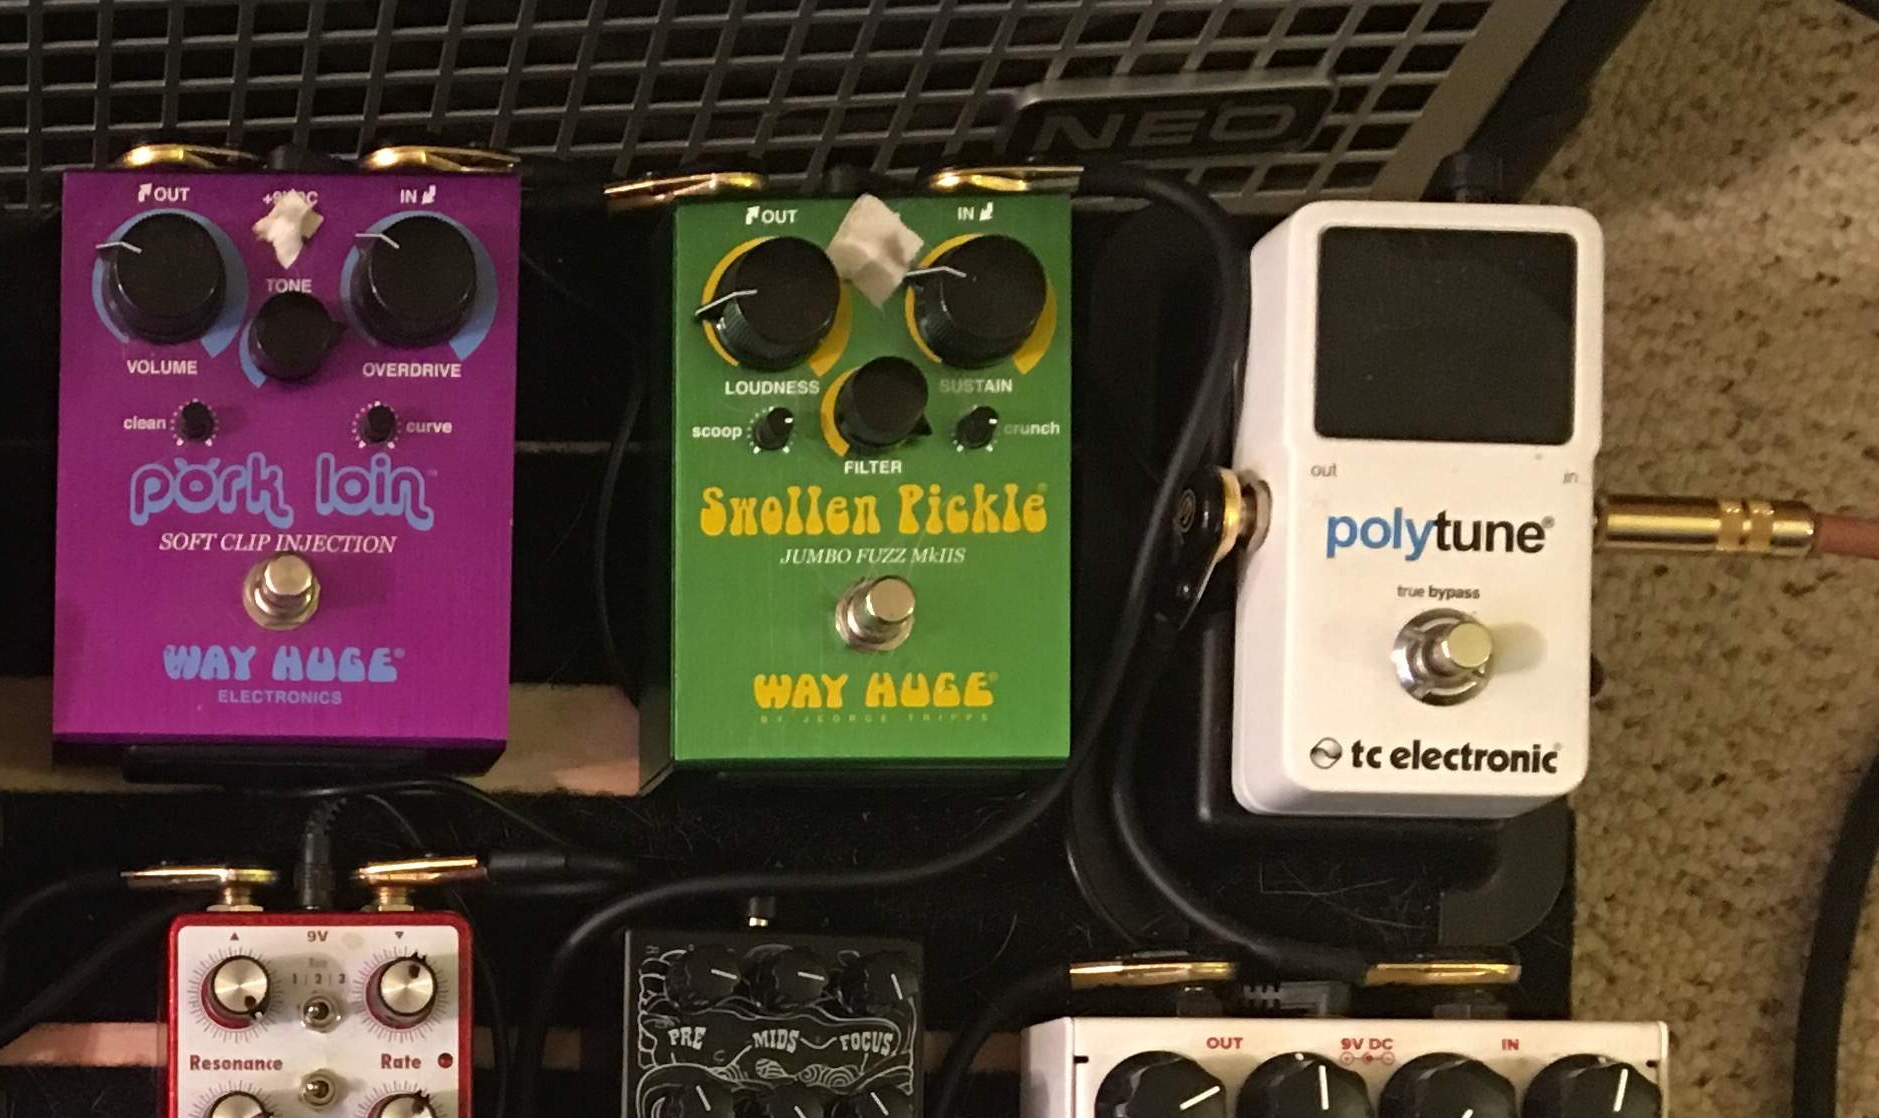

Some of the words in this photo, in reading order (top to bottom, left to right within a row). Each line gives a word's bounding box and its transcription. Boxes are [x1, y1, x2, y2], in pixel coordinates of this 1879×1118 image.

[1032, 106, 1296, 151] NEO
[154, 187, 190, 201] OUT
[400, 190, 416, 203] IN
[761, 210, 798, 224] OUT
[958, 208, 974, 220] IN
[266, 279, 311, 292] TONE
[127, 361, 197, 374] VOLUME
[362, 363, 461, 377] OVERDRIVE
[725, 381, 820, 396] LOUDNESS
[939, 379, 1012, 393] SUSTAIN
[124, 416, 166, 430] clean
[406, 421, 452, 433] curve
[1005, 422, 1060, 435] crunch
[692, 425, 742, 440] scoop
[844, 461, 902, 474] FILTER
[1310, 464, 1337, 477] out
[130, 452, 294, 529] pork
[316, 452, 434, 531] loin
[700, 485, 881, 536] Swollen
[898, 483, 1047, 534] Pickle
[1326, 507, 1546, 561] polytune
[159, 533, 216, 551] SOFT
[220, 534, 271, 551] CLIP
[276, 536, 396, 552] INJECTION
[780, 549, 851, 565] JUMBO
[856, 549, 906, 564] FUZZ
[1397, 585, 1425, 598] true
[1428, 586, 1480, 600] bypass
[163, 645, 256, 679] WAY
[272, 647, 397, 682] HUGE
[753, 673, 848, 708] WAY
[864, 672, 994, 708] HUGE
[218, 690, 342, 705] ELECTRONICS
[1351, 741, 1381, 769] tc
[1390, 740, 1558, 773] electronic
[307, 931, 328, 942] 9V
[668, 1026, 707, 1050] PRE
[752, 1029, 800, 1053] MIDS
[839, 1032, 893, 1056] FOCUS
[1207, 1037, 1243, 1050] OUT
[1341, 1038, 1364, 1051] 9V
[1368, 1038, 1394, 1051] DC
[1501, 1038, 1520, 1051] IN
[189, 1055, 283, 1071] Resonance
[381, 1054, 422, 1069] Rate
